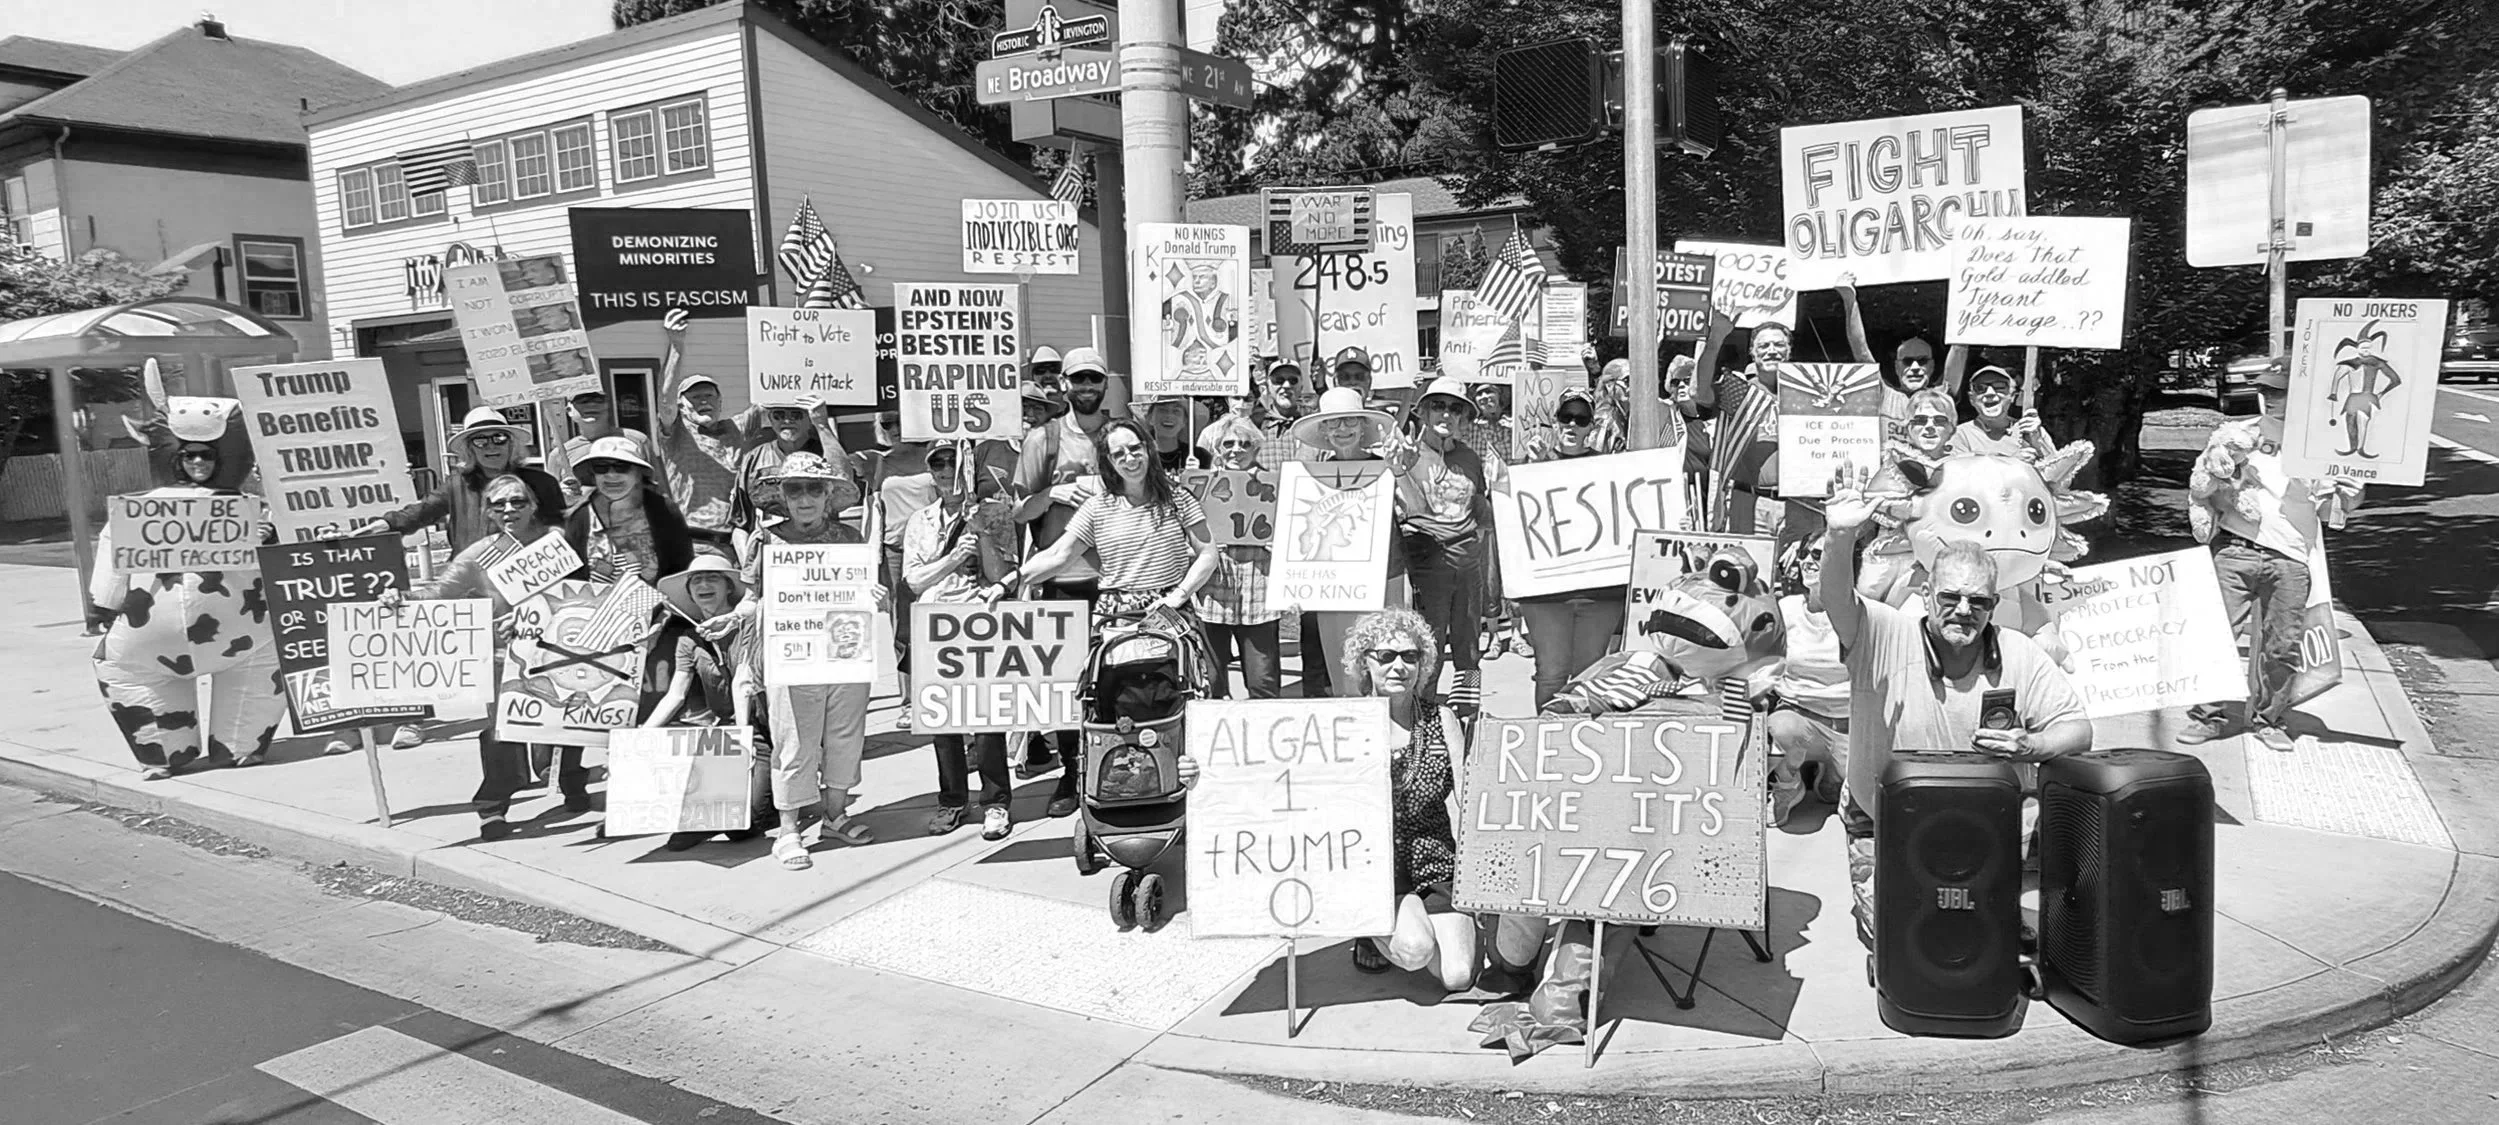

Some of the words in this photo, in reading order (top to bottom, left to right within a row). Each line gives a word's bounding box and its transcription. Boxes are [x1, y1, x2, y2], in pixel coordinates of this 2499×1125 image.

[996, 35, 1030, 51] HISTORIC
[1063, 22, 1105, 40] IRVINGTON
[987, 76, 1000, 94] NE
[1009, 59, 1112, 91] Broadway
[1182, 65, 1194, 82] NE
[1801, 124, 1990, 209] FIGHT
[1301, 196, 1341, 208] WAR
[1308, 212, 1335, 224] NO
[611, 236, 718, 249] DEMONIZING
[1175, 227, 1190, 240] NO
[1193, 227, 1226, 241] KINGS
[1305, 227, 1347, 241] MORE
[619, 252, 716, 265] MINORITIES
[973, 251, 1075, 265] RESIST
[1146, 245, 1159, 267] K
[1165, 241, 1200, 254] Donald
[1204, 242, 1236, 257] Trump
[1967, 245, 2017, 263] Does
[470, 276, 489, 286] AM
[1293, 254, 1389, 291] 248.5
[464, 298, 493, 310] NOT
[508, 289, 567, 306] CORRUPT
[590, 292, 638, 308] THIS
[642, 292, 660, 307] IS
[665, 290, 749, 306] FASCISM
[910, 289, 951, 306] AND
[959, 289, 1004, 307] NOW
[1966, 287, 2050, 314] Tyrant
[793, 310, 819, 321] OUR
[901, 310, 1014, 331] EPSTEIN'S
[1367, 303, 1388, 326] of
[2333, 303, 2353, 317] NO
[2361, 303, 2418, 318] JOKERS
[482, 323, 514, 336] WON
[760, 320, 799, 347] Right
[802, 333, 815, 344] to
[819, 324, 851, 343] Vote
[476, 347, 508, 361] 2020
[512, 335, 578, 356] ELECTION
[901, 334, 985, 356] BESTIE
[993, 334, 1016, 356] IS
[805, 357, 814, 367] is
[256, 371, 351, 397] Trump
[499, 369, 518, 380] AM
[760, 372, 802, 391] UNDER
[810, 372, 854, 391] Attack
[903, 363, 1017, 390] RAPING
[518, 391, 526, 401] A
[1145, 382, 1172, 391] RESIST
[1182, 382, 1239, 394] indivisible.org
[1525, 378, 1553, 397] NO
[257, 405, 380, 437] Benefits
[930, 393, 992, 433] US
[1805, 421, 1823, 430] ICE
[1799, 436, 1821, 445] Due
[1832, 436, 1875, 445] Process
[277, 442, 386, 473] TRUMP,
[1811, 450, 1826, 459] for
[2325, 465, 2339, 476] JD
[2343, 465, 2377, 478] Vance
[285, 486, 334, 511] not
[341, 483, 400, 509] you,
[210, 499, 240, 518] BE
[1517, 477, 1672, 560] RESIST
[141, 519, 249, 546] COWED!
[1230, 511, 1272, 540] 1/6
[115, 547, 175, 569] FIGHT
[180, 549, 256, 567] FASCISM
[290, 552, 315, 567] IS
[324, 547, 376, 563] THAT
[498, 538, 568, 585] IMPEACH
[772, 551, 825, 564] HAPPY
[522, 555, 577, 593] NOW!!!
[802, 567, 841, 581] JULY
[1286, 569, 1308, 580] SHE
[1312, 568, 1337, 580] HAS
[2129, 560, 2176, 588] NOT
[276, 574, 356, 600] TRUE
[778, 591, 811, 603] Don't
[815, 591, 829, 602] let
[833, 590, 856, 601] HIM
[1283, 584, 1314, 599] NO
[1320, 584, 1368, 600] KING
[2075, 591, 2162, 619] PROTECT
[280, 610, 306, 626] OR
[343, 603, 474, 631] IMPEACH
[514, 606, 541, 626] NO
[775, 620, 801, 631] take
[804, 619, 824, 630] the
[929, 607, 1074, 642] DON'T
[348, 628, 486, 658] CONVICT
[511, 627, 544, 640] WAR
[2062, 618, 2187, 654] DEMOCRACY
[284, 639, 327, 660] SEE
[937, 645, 1064, 679] STAY
[2090, 657, 2129, 673] From
[2133, 654, 2156, 665] the
[351, 659, 479, 690] REMOVE
[2084, 674, 2198, 704] PRESIDENT!
[365, 704, 423, 716] channel
[507, 699, 542, 718] NO
[920, 682, 1079, 728] SILENT
[667, 728, 742, 756] TIME
[1208, 714, 1371, 767] ALGAE:
[1498, 721, 1737, 787] RESIST
[1476, 790, 1582, 832] LIKE
[1630, 786, 1724, 837] IT'S
[1521, 843, 1679, 914] 1776
[1936, 887, 1975, 910] JBL
[2161, 888, 2192, 912] JBL
